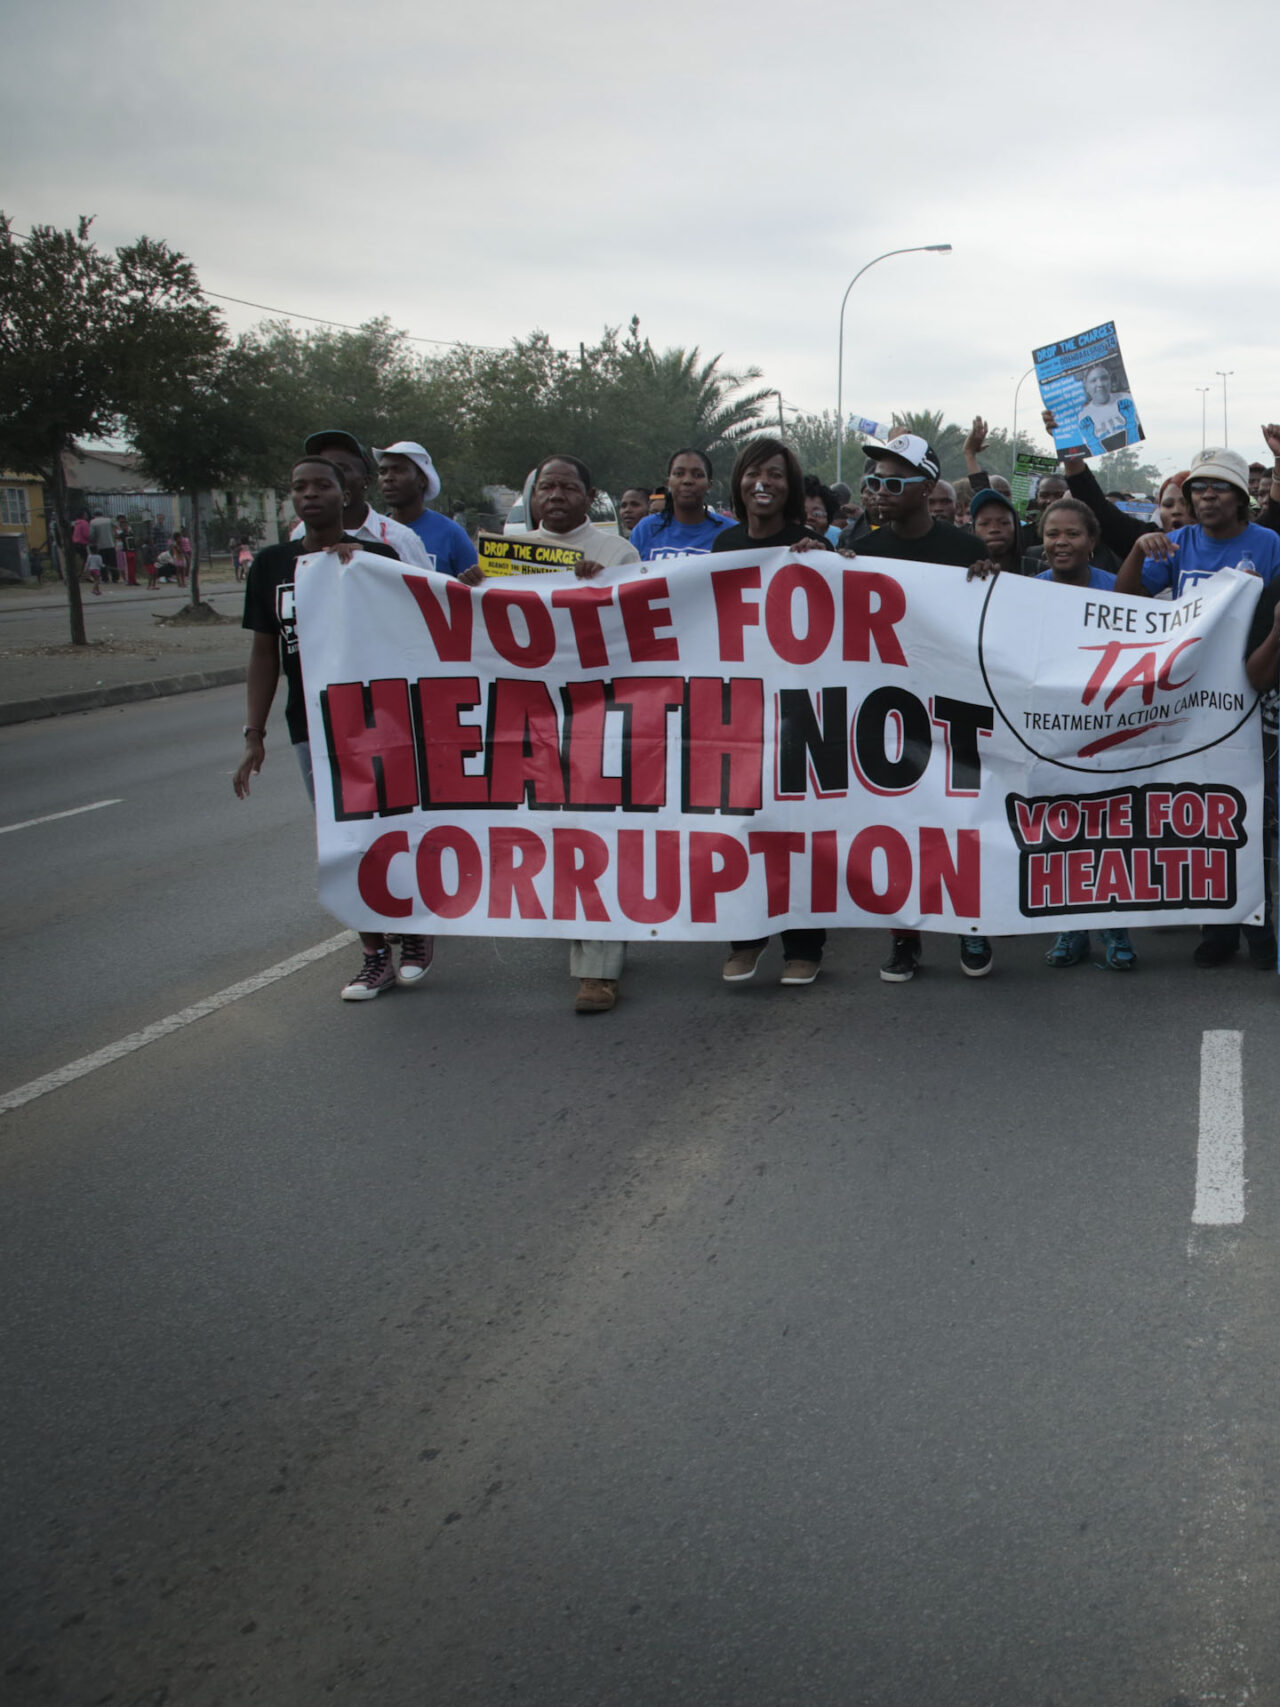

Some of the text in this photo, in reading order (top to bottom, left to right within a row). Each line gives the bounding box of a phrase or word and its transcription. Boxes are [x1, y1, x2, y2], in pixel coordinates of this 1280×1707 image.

[1036, 323, 1114, 362] DROP THE CHARGES
[484, 542, 582, 565] DROP THE CHARGES
[402, 563, 908, 669] VOTE FOR
[1083, 597, 1204, 634] FREE STATE
[1077, 636, 1204, 713] TAC
[1023, 689, 1245, 731] TREATMENT ACTION CAMPAIGN
[320, 675, 994, 822] HEALTH NOT
[1014, 791, 1239, 845] VOTE FOR
[357, 825, 981, 924] CORRUPTION
[1028, 848, 1228, 908] HEALTH
